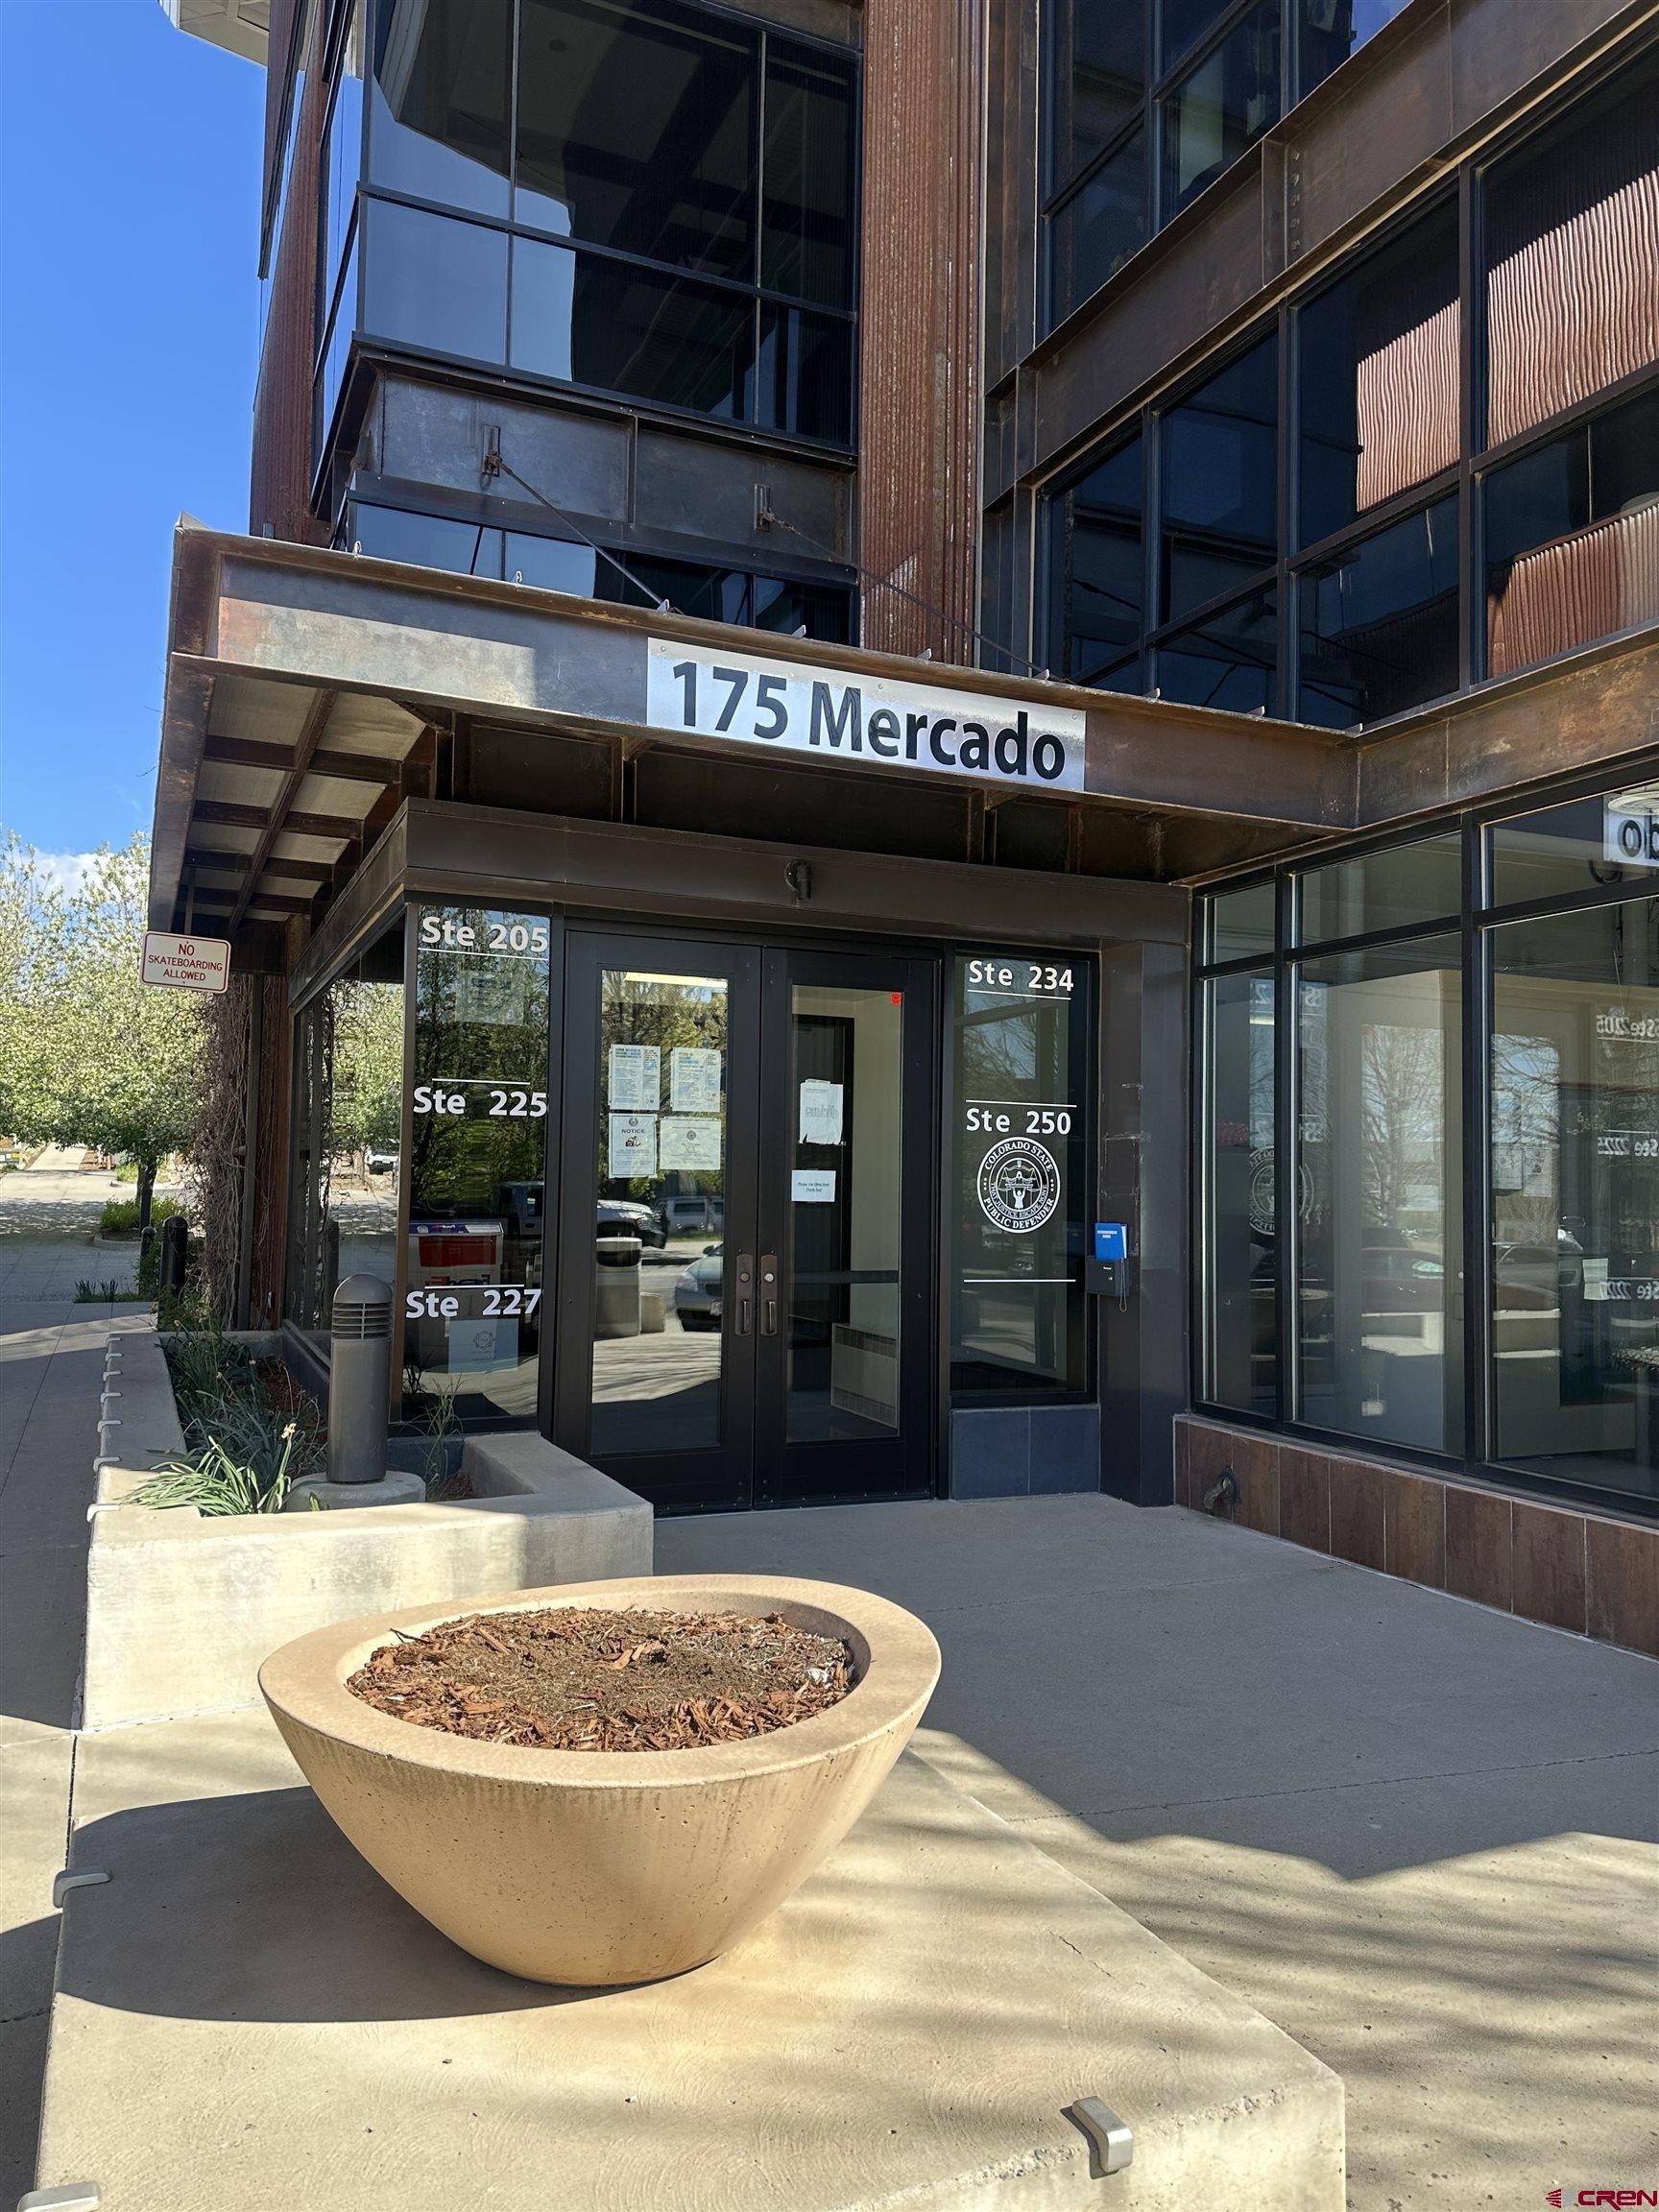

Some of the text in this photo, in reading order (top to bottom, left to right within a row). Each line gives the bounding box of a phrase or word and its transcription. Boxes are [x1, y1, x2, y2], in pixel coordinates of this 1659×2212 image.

[672, 660, 1066, 780] 175 Mercado
[178, 943, 195, 956] NO
[421, 916, 548, 952] Ste 205
[148, 954, 223, 972] SKATEBOARDING
[162, 968, 206, 981] ALLOWED
[969, 960, 1074, 992] Ste 234
[413, 1086, 547, 1118] Ste 225
[966, 1107, 1071, 1135] Ste 250
[984, 1141, 1054, 1172] COLORADO STATE
[983, 1197, 1055, 1229] PUBLIC DEFENDER
[405, 1288, 541, 1319] Ste 227
